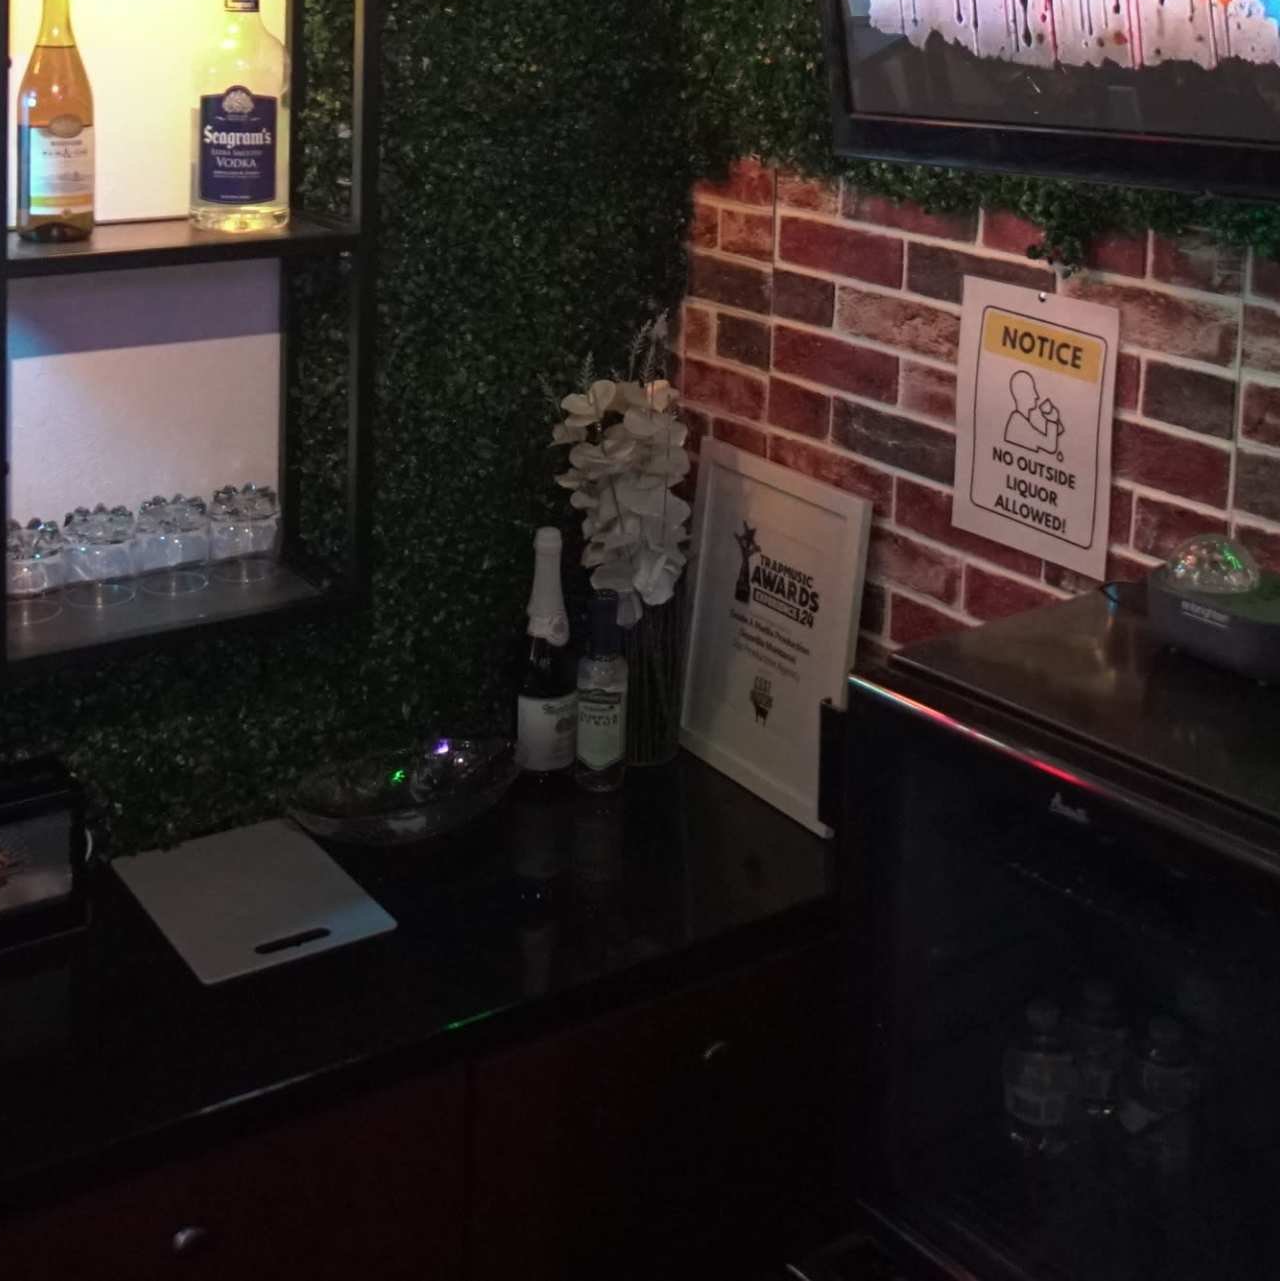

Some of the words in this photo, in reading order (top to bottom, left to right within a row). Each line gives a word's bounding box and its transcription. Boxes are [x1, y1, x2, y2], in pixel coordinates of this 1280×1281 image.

[203, 126, 272, 148] Seagram's
[1001, 325, 1084, 369] NOTICE
[992, 447, 1014, 466] NO
[1016, 456, 1077, 490] OUTSIDE
[1006, 475, 1058, 507] LIQUOR
[994, 495, 1066, 533] ALLOWED!
[751, 566, 820, 613] AWARDS
